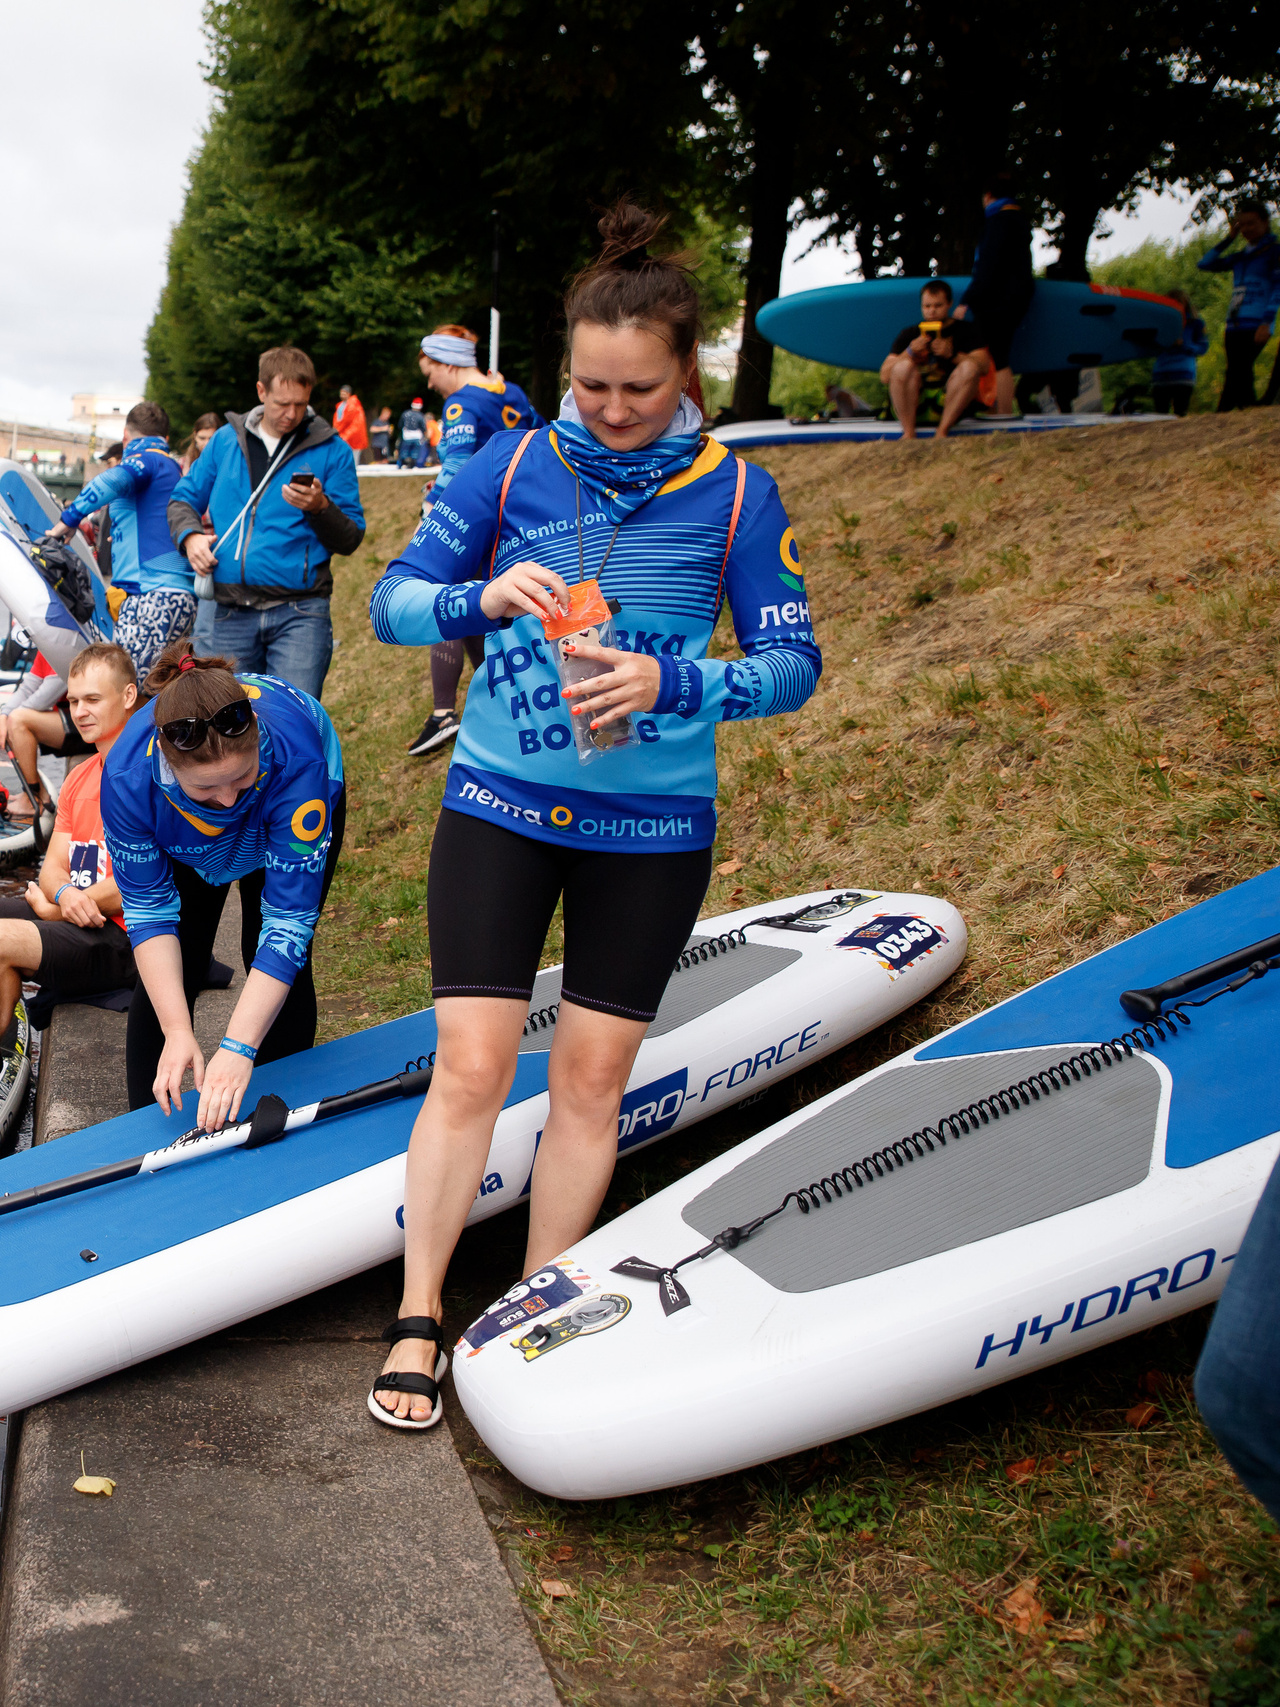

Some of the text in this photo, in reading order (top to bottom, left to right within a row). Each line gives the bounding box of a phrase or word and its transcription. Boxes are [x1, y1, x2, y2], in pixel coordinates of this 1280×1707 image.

[759, 601, 811, 630] лен
[510, 681, 561, 720] на
[518, 718, 661, 756] вое
[459, 781, 693, 838] лента онлайн
[876, 920, 933, 959] 0343
[618, 1020, 822, 1141] DRO-FORCE
[974, 1247, 1239, 1369] HYDRO-
